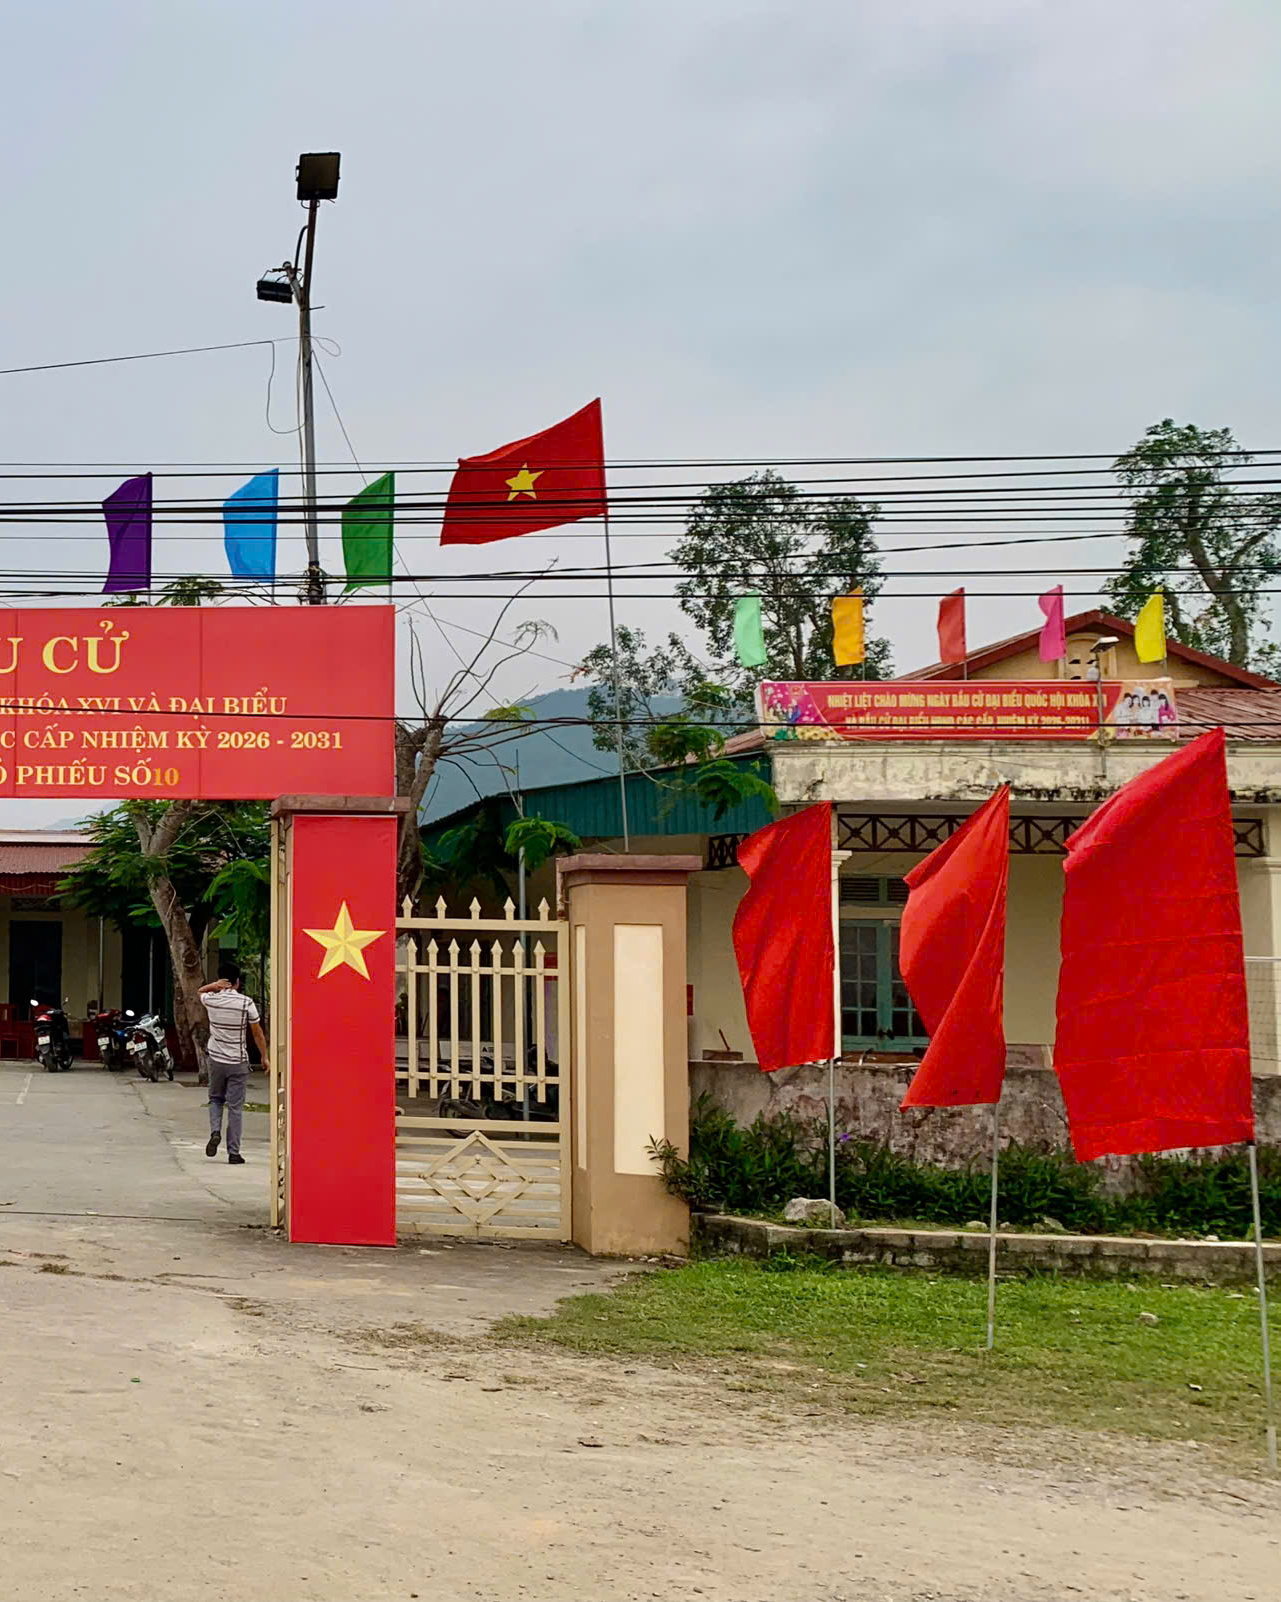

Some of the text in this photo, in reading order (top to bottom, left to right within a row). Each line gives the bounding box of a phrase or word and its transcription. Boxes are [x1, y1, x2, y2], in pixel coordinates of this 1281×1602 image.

[42, 620, 130, 673] CỬ
[0, 692, 69, 715] KHÓA
[76, 697, 122, 715] XVI
[127, 692, 161, 714] VÀ
[169, 697, 215, 719] ĐẠI
[223, 687, 287, 714] BIỂU
[854, 691, 871, 710] LIỆT
[23, 723, 74, 749] CẤP
[81, 725, 168, 752] NHIỆM
[176, 725, 212, 749] KỲ
[217, 731, 270, 749] 2026
[290, 731, 343, 749] 2031
[15, 757, 107, 786] PHIẾU
